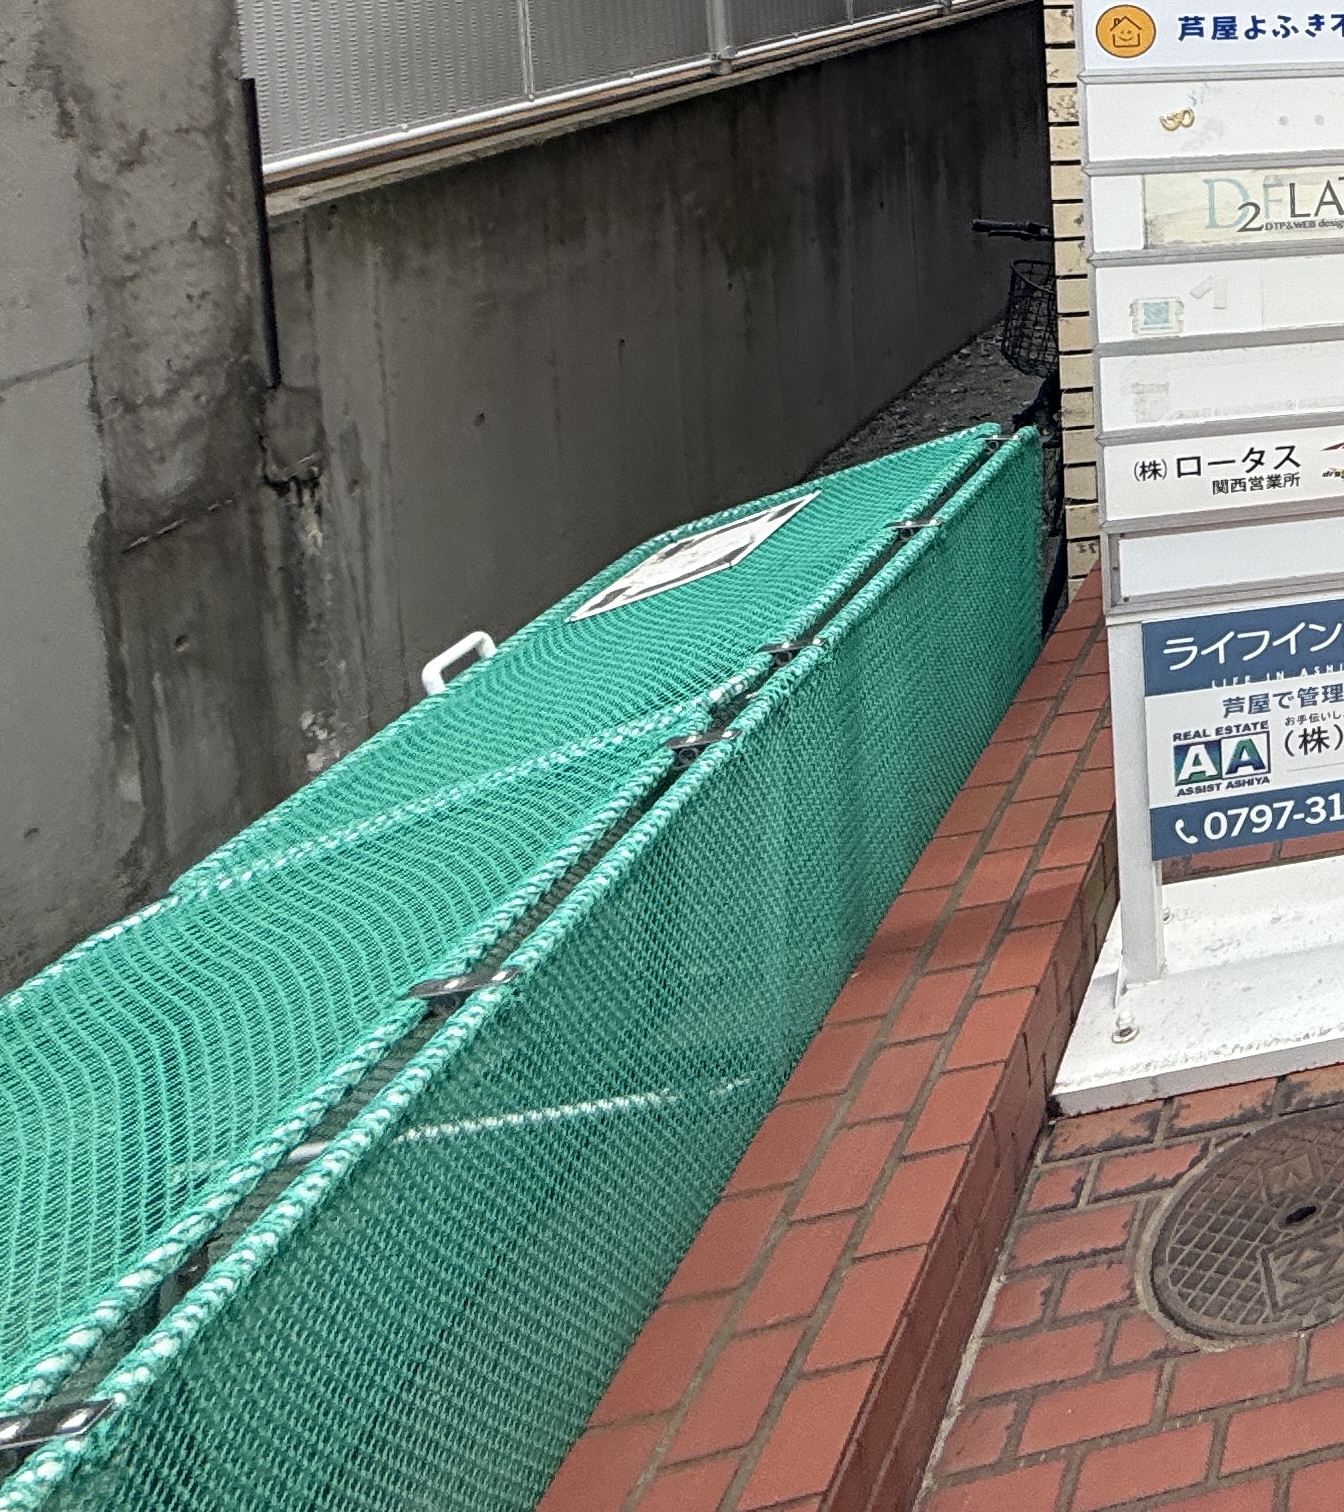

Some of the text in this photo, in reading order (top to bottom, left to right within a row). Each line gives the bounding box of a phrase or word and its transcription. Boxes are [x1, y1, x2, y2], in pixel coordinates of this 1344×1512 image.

[1212, 472, 1301, 495] 関西営業所
[1266, 670, 1285, 682] IN
[1173, 720, 1269, 742] REAL ESTATE
[1176, 776, 1271, 797] ASSIST ASHIYA
